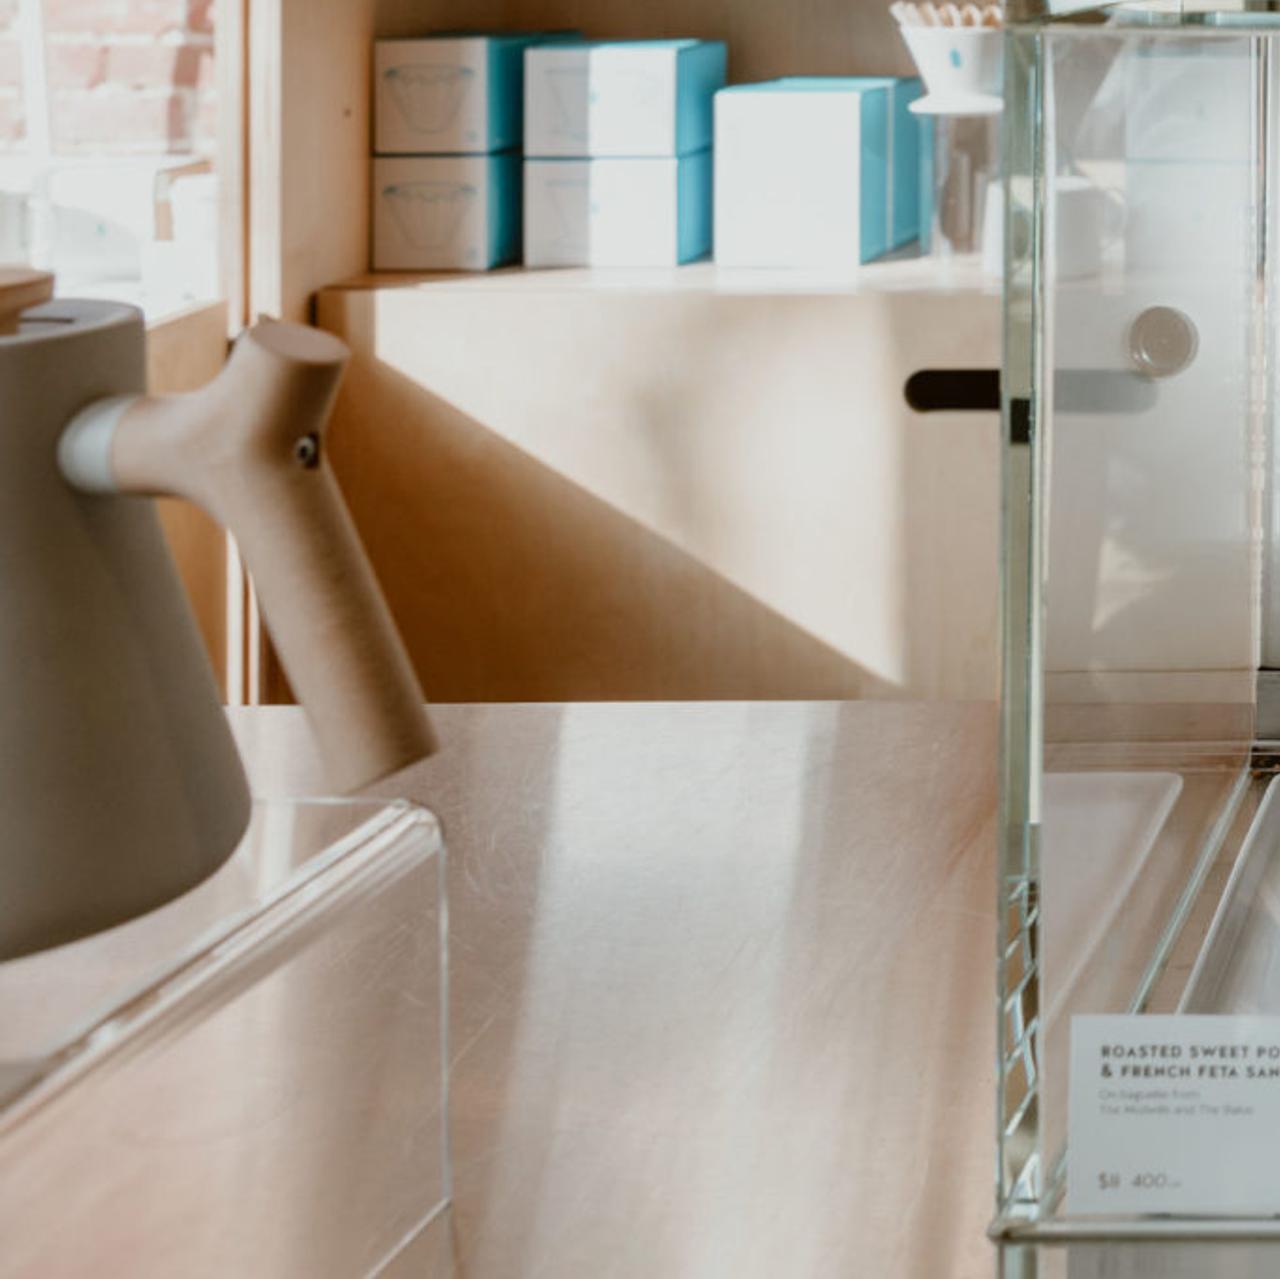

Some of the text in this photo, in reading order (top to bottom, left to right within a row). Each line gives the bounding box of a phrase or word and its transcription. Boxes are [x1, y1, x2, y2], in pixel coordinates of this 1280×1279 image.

[1101, 1045, 1182, 1059] ROASTED
[1190, 1045, 1249, 1059] SWEET
[1100, 1065, 1112, 1078] &
[1121, 1065, 1191, 1078] FRENCH
[1199, 1065, 1237, 1078] FETA
[1132, 1172, 1168, 1189] 400
